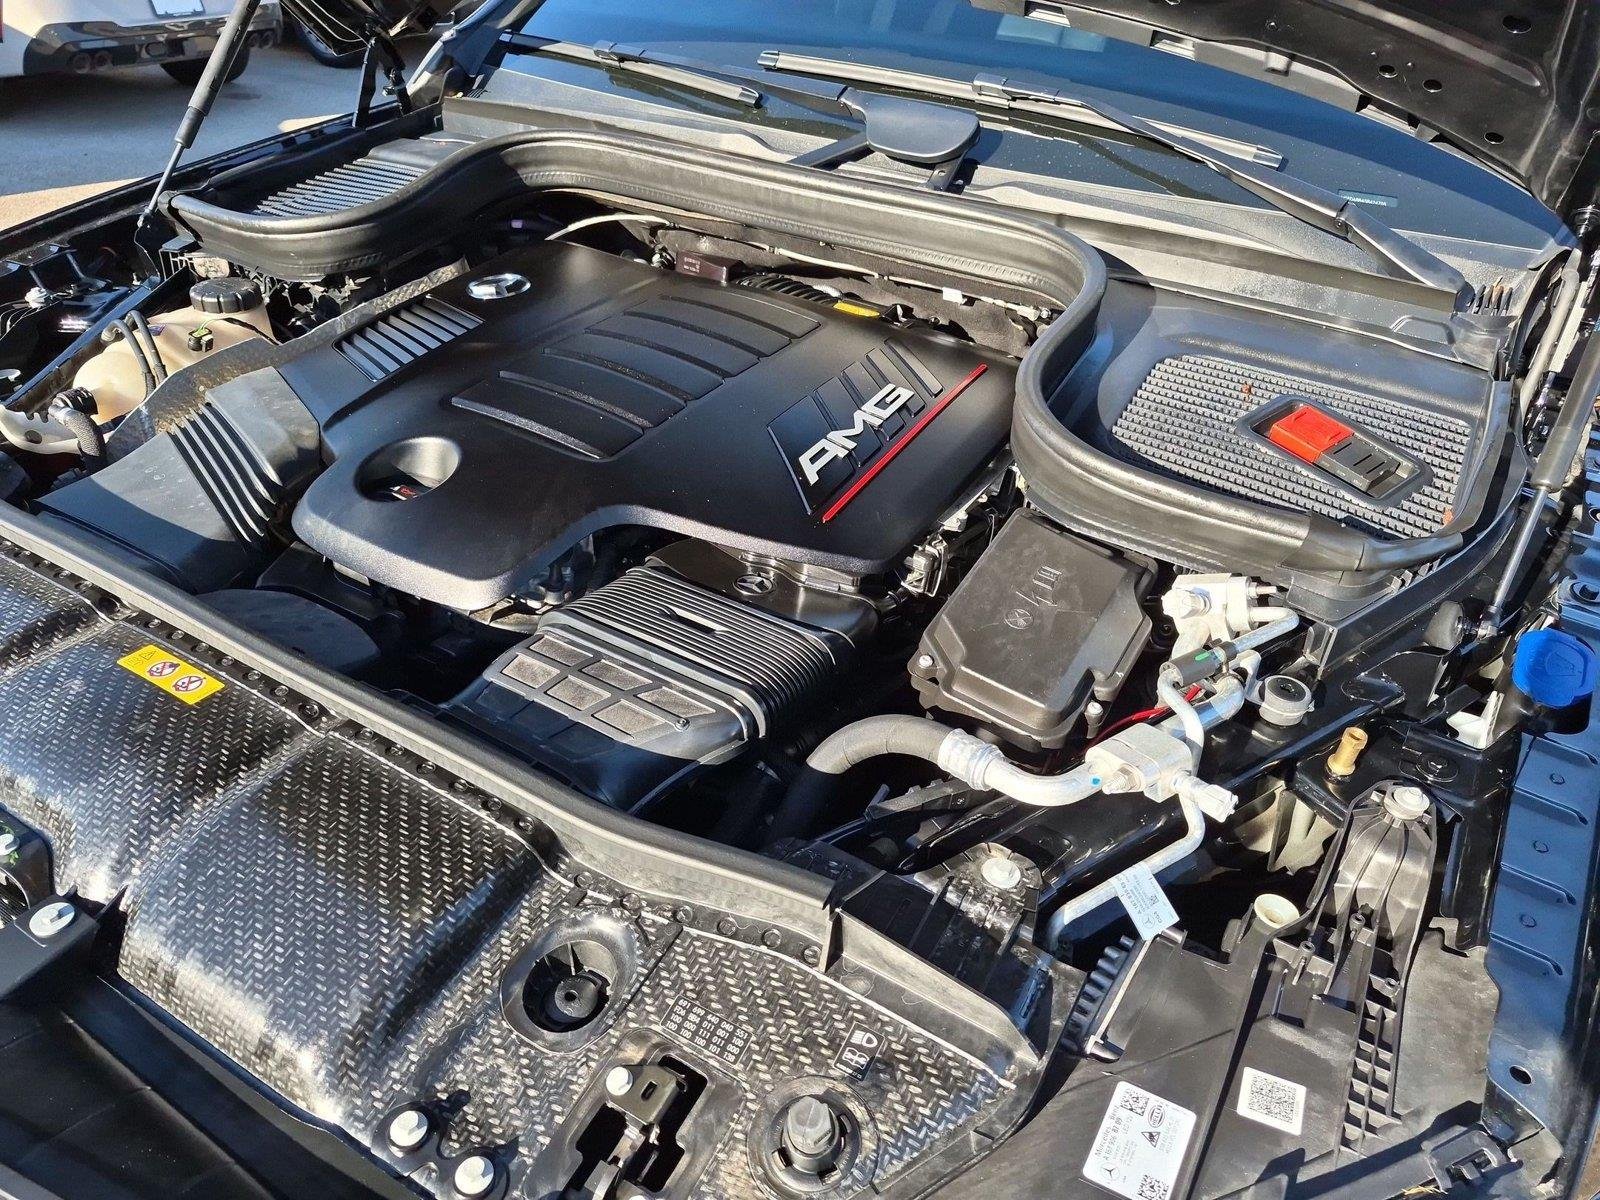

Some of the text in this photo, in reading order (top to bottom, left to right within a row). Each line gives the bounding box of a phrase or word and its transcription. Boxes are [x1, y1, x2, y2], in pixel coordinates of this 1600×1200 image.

[799, 383, 914, 486] AMG
[665, 1020, 678, 1031] 100
[680, 1028, 692, 1039] 100
[694, 1036, 707, 1047] 100
[708, 1043, 721, 1054] 101
[670, 1013, 740, 1055] 100 000 111 011 000
[692, 1006, 706, 1017] 699
[706, 1013, 720, 1024] 440
[720, 1021, 734, 1032] 040
[734, 1028, 748, 1040] 551
[701, 1020, 715, 1031] 011
[716, 1028, 730, 1039] 001
[731, 1036, 744, 1047] 100
